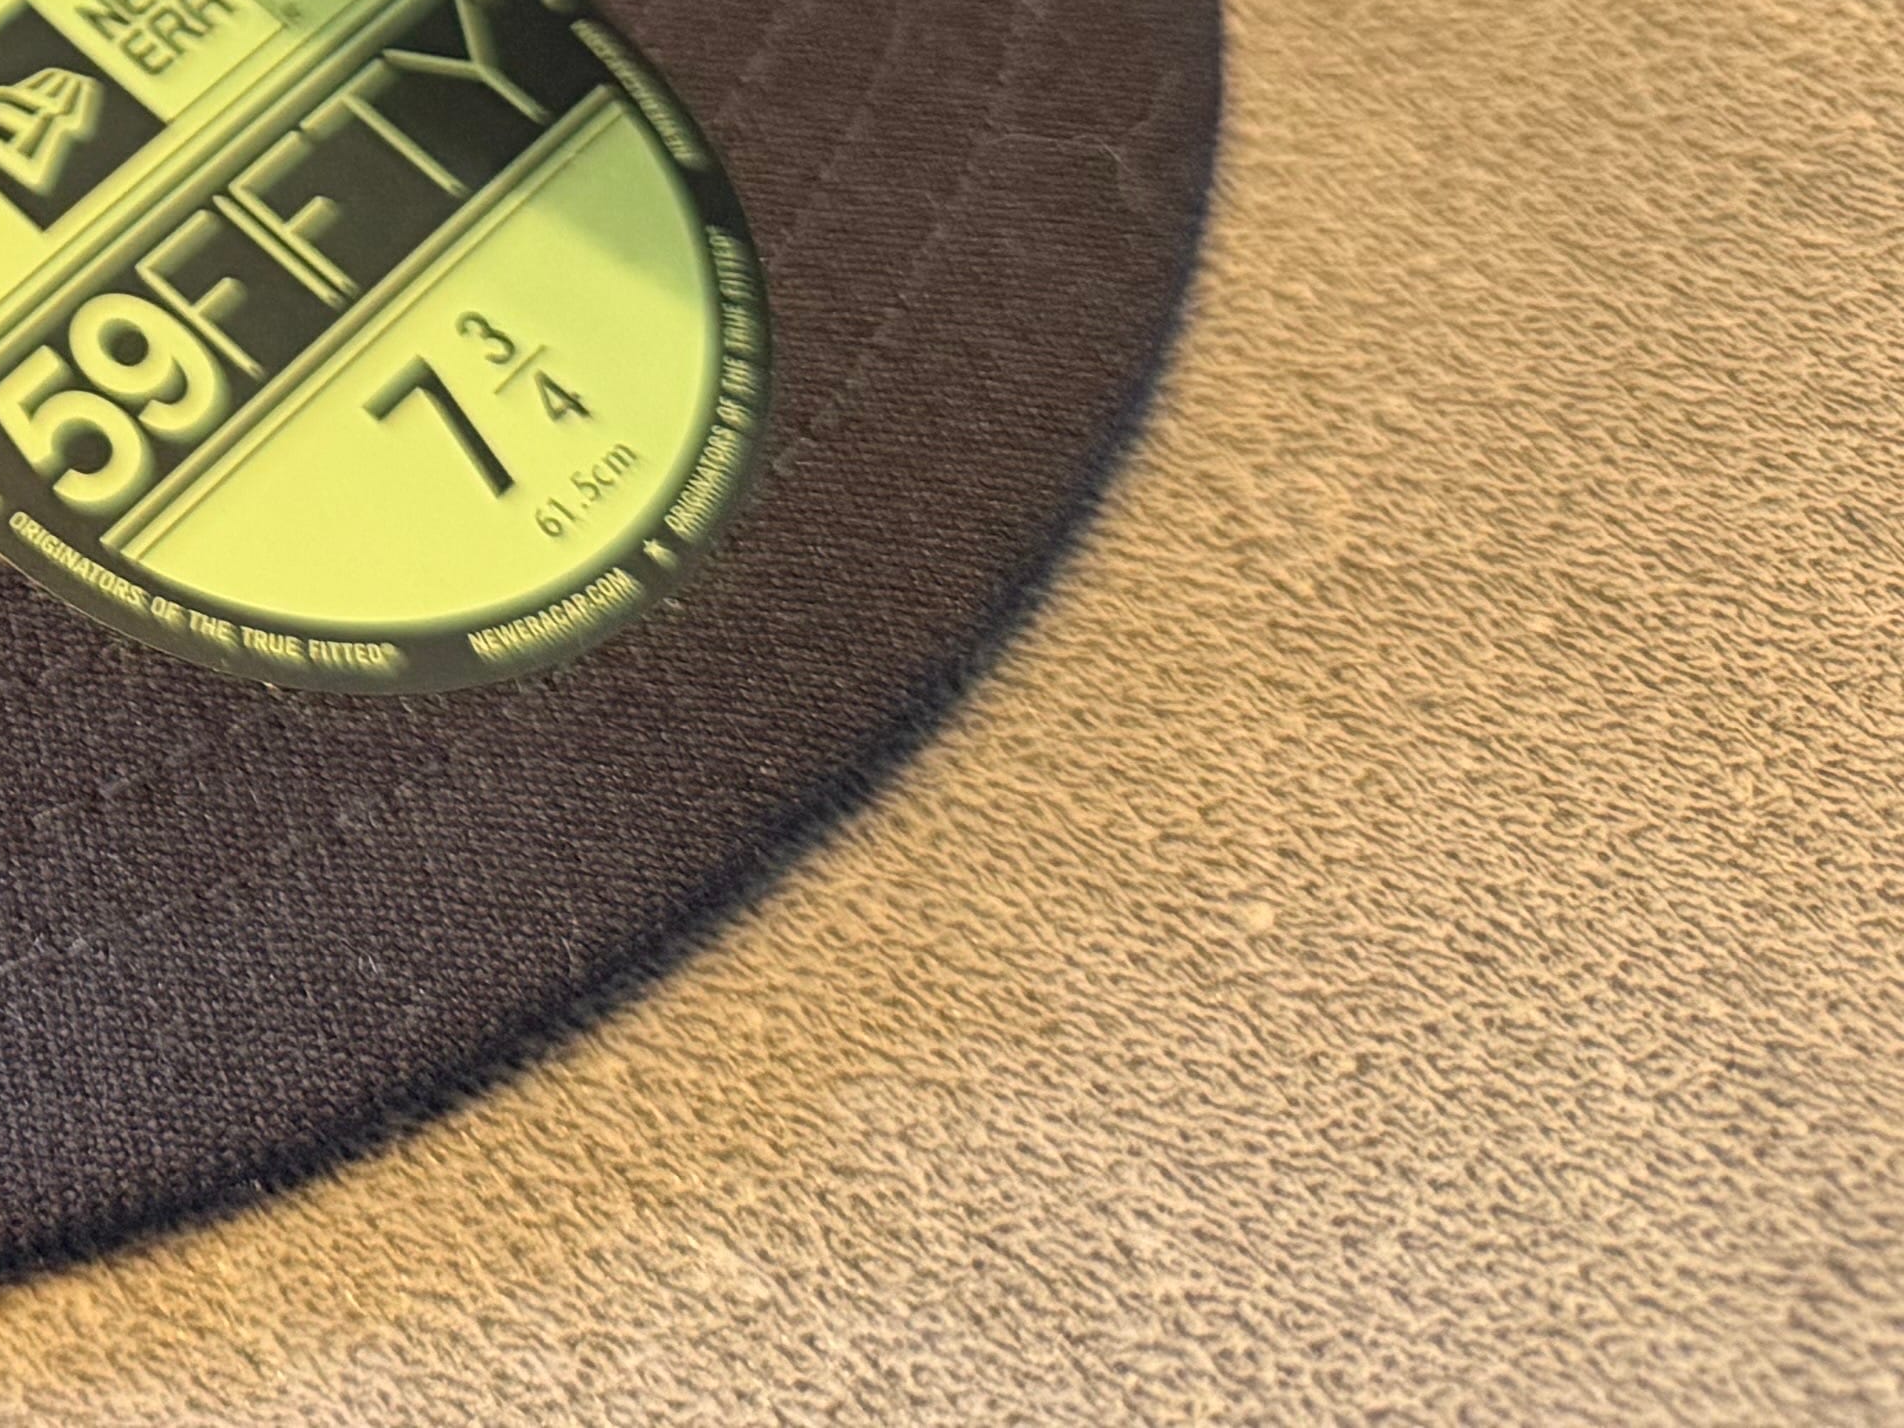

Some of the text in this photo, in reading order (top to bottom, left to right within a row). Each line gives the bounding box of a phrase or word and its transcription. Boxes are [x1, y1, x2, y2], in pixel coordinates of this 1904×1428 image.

[363, 354, 515, 498] 7
[664, 424, 738, 540] ORIGINATORS
[535, 443, 638, 538] 61.5cm
[9, 510, 145, 608] ORIGINATORS
[150, 595, 180, 622] OF
[189, 609, 231, 642] THE
[240, 625, 300, 658] TRUE
[467, 566, 637, 657] NEWERACAP.COM
